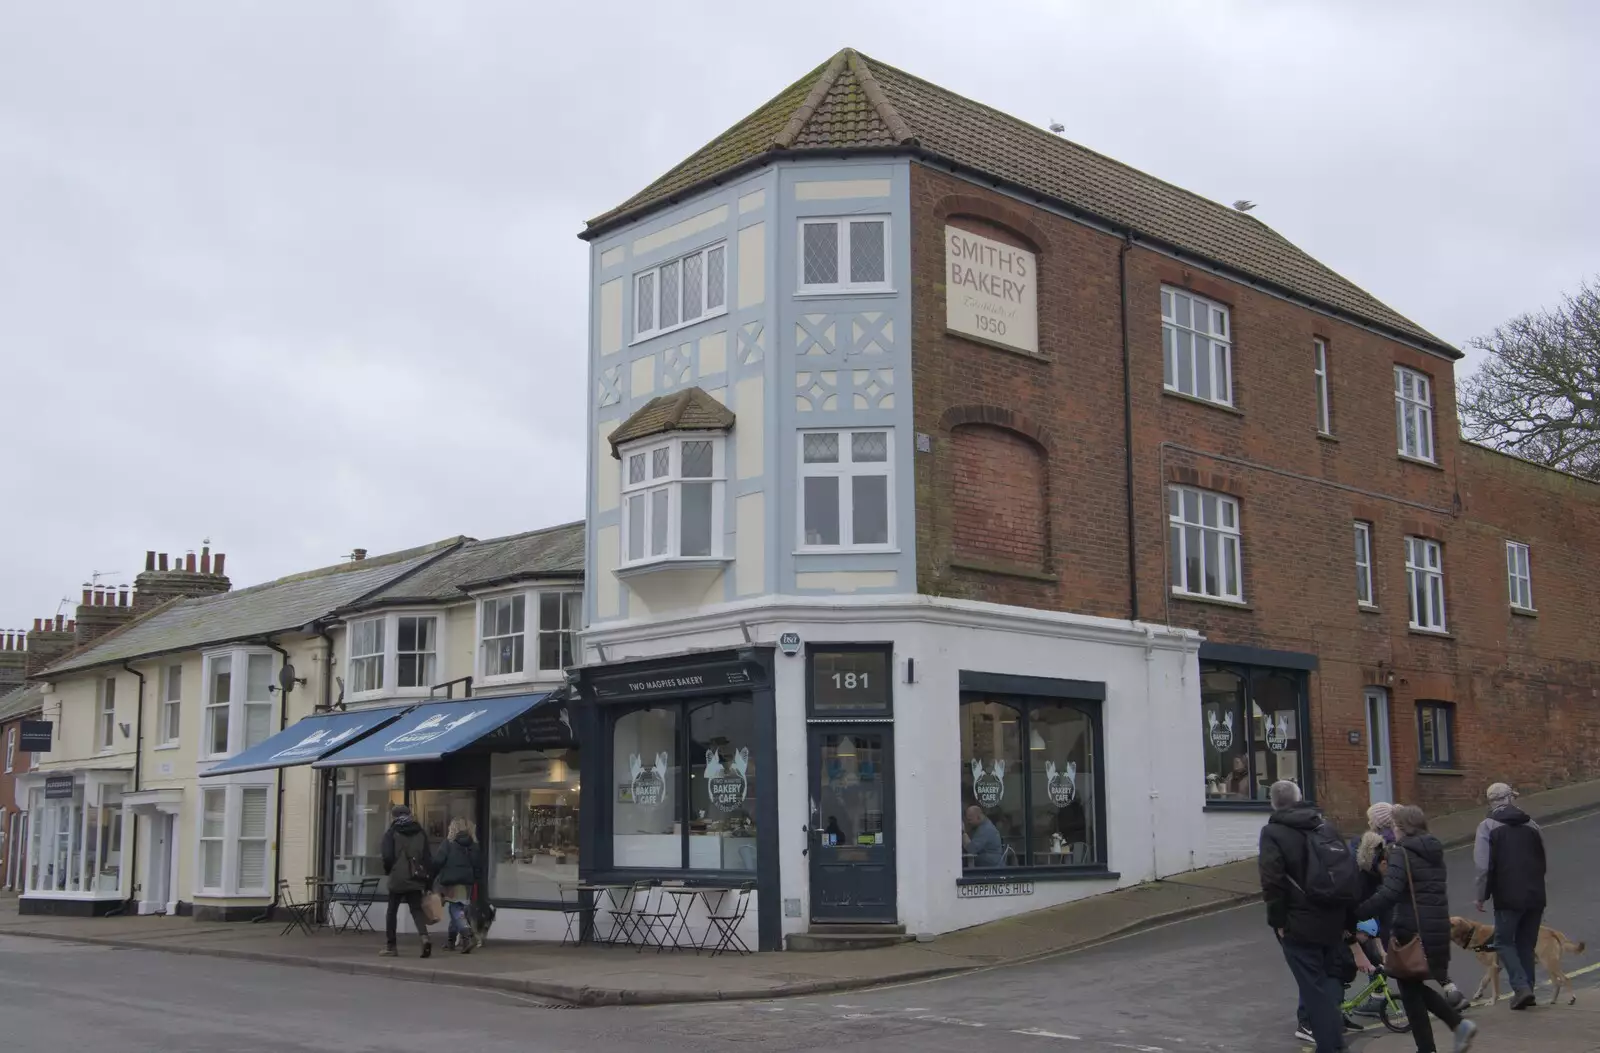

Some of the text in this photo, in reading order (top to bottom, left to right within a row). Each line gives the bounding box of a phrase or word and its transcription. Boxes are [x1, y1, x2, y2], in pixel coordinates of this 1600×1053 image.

[951, 235, 1027, 277] SMITH'S
[952, 263, 1026, 304] BAKERY
[975, 314, 1006, 336] 1950
[629, 675, 704, 692] TWO MAGPIES BAKERY
[831, 672, 869, 689] 181
[636, 786, 661, 795] BAKERY
[713, 784, 742, 793] BAKERY
[977, 786, 1000, 794] BAKERY
[640, 795, 657, 805] CAFE
[719, 794, 737, 803] CAFE
[961, 883, 1031, 896] CHOPPING'S HILL
